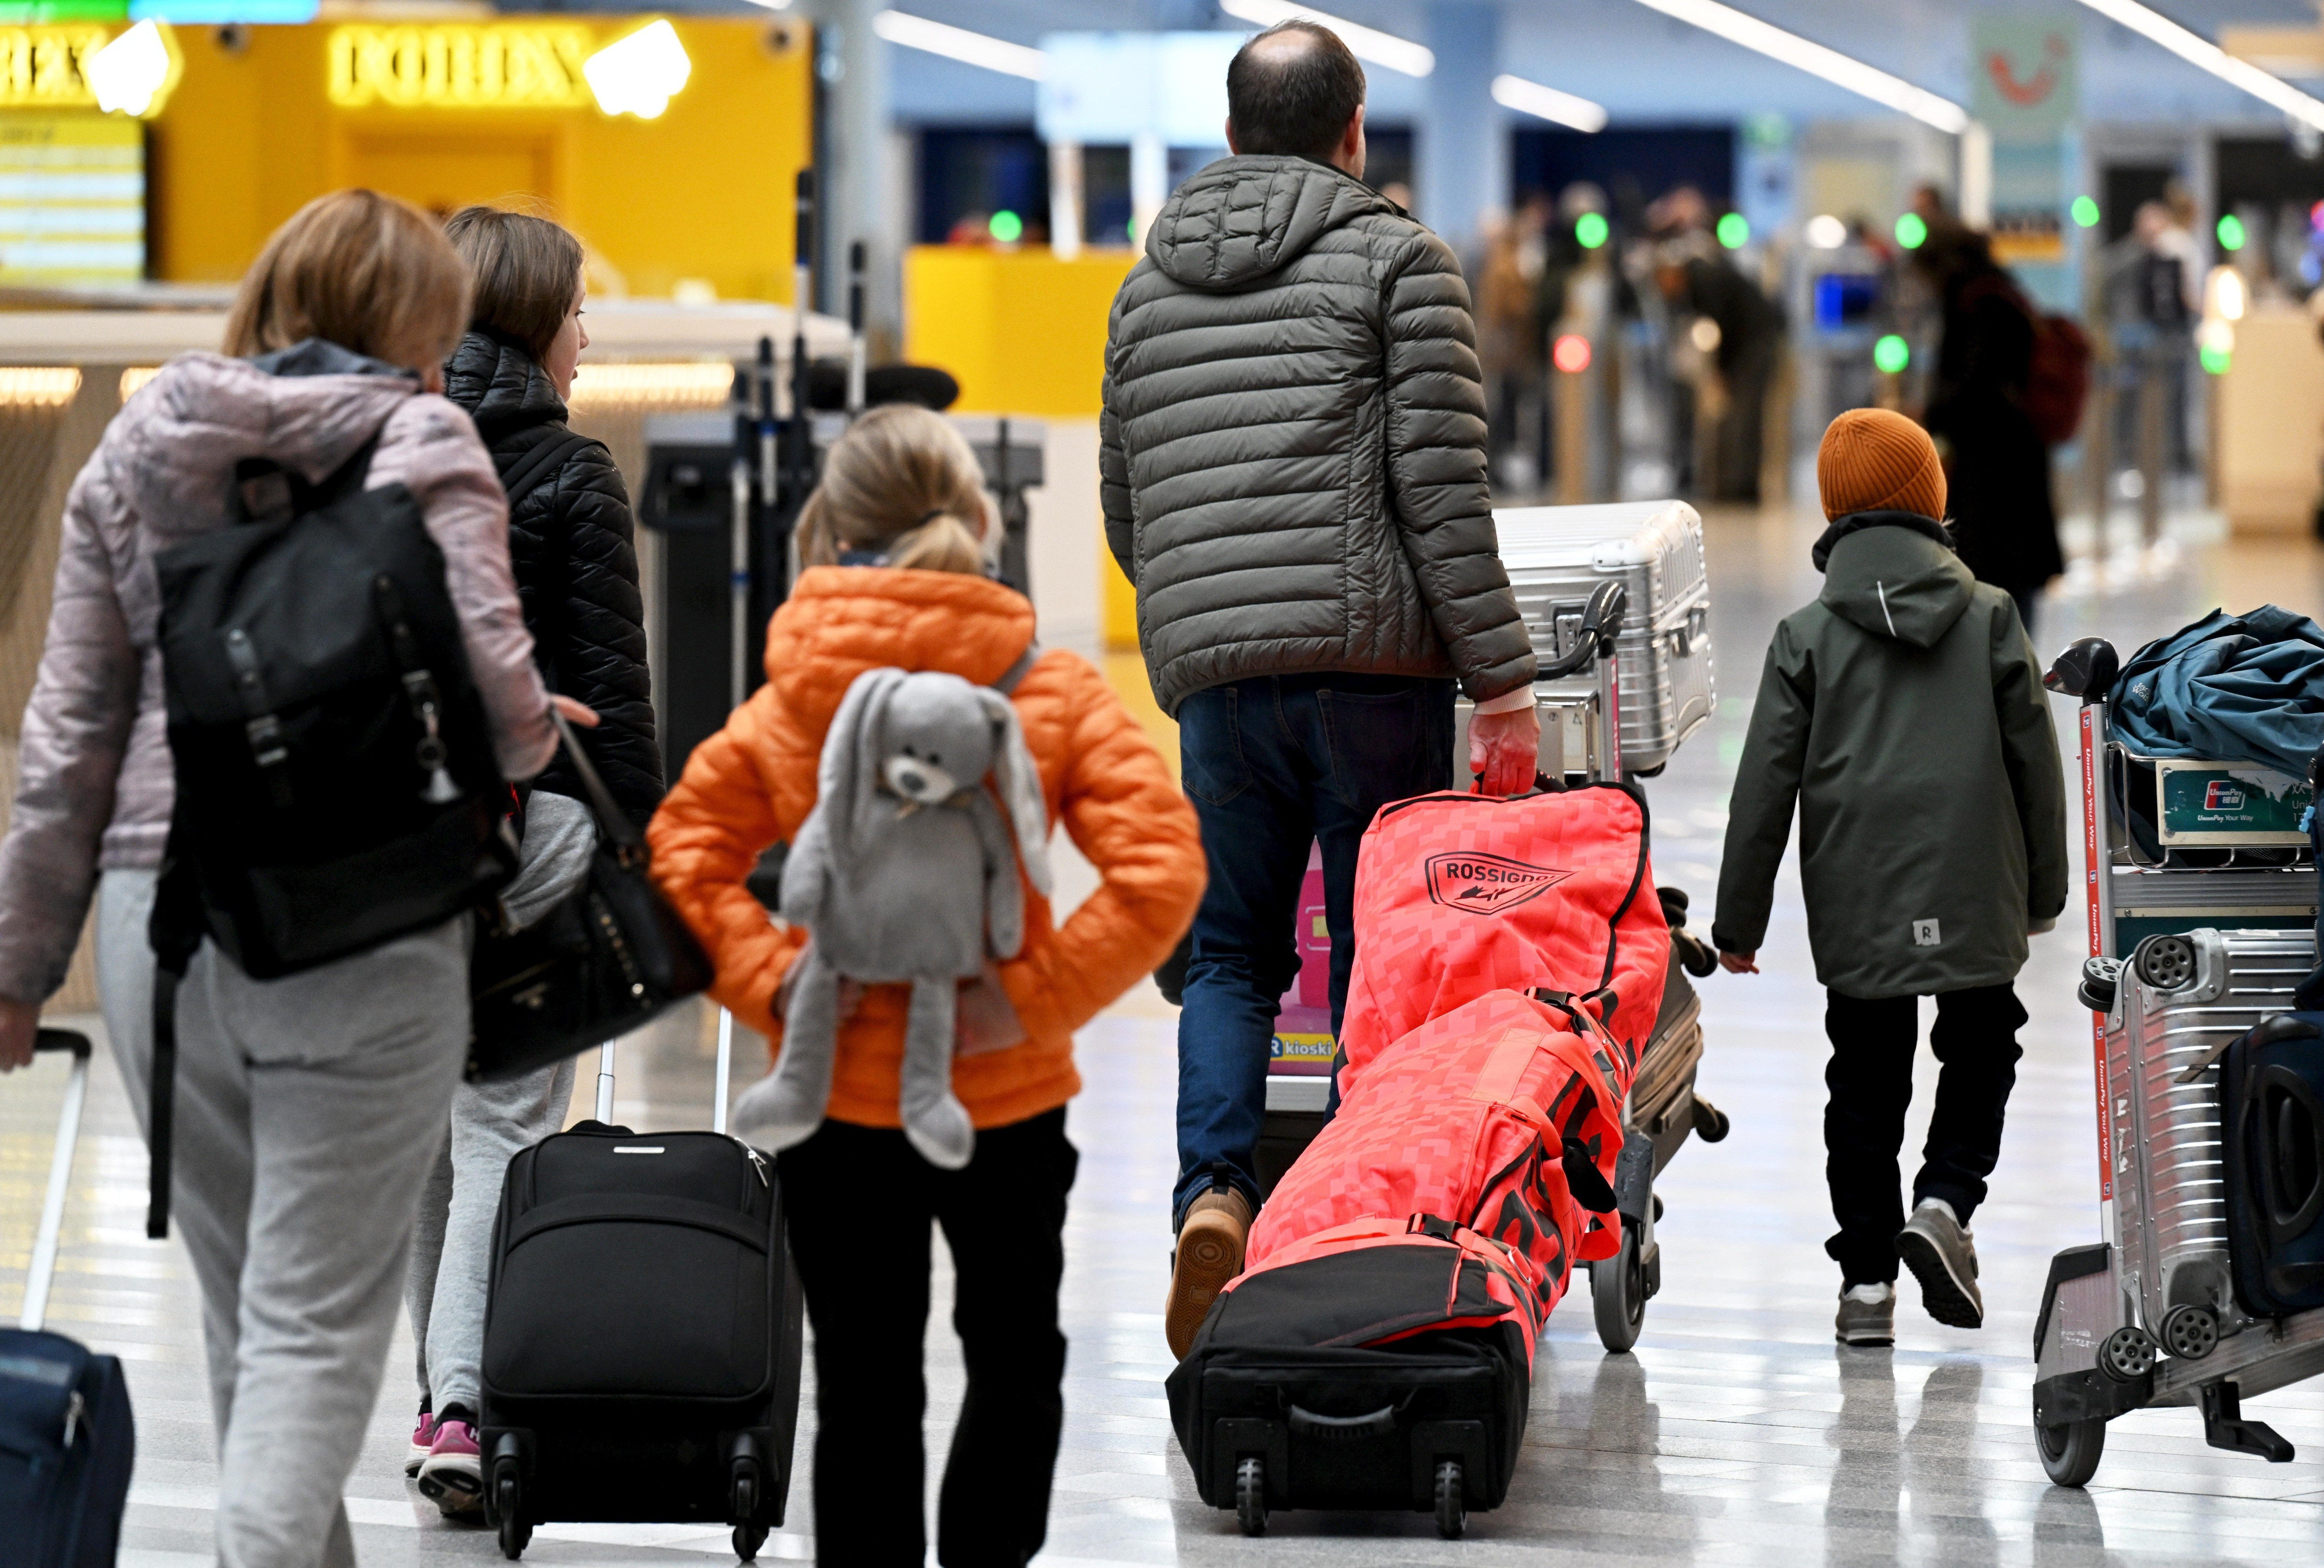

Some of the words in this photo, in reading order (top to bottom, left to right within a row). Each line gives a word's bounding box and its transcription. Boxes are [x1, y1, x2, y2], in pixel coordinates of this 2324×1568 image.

[2210, 788, 2242, 798] UnionPay
[2197, 815, 2224, 823] UnionPay
[1922, 926, 1931, 939] R
[1285, 1040, 1332, 1055] kioski
